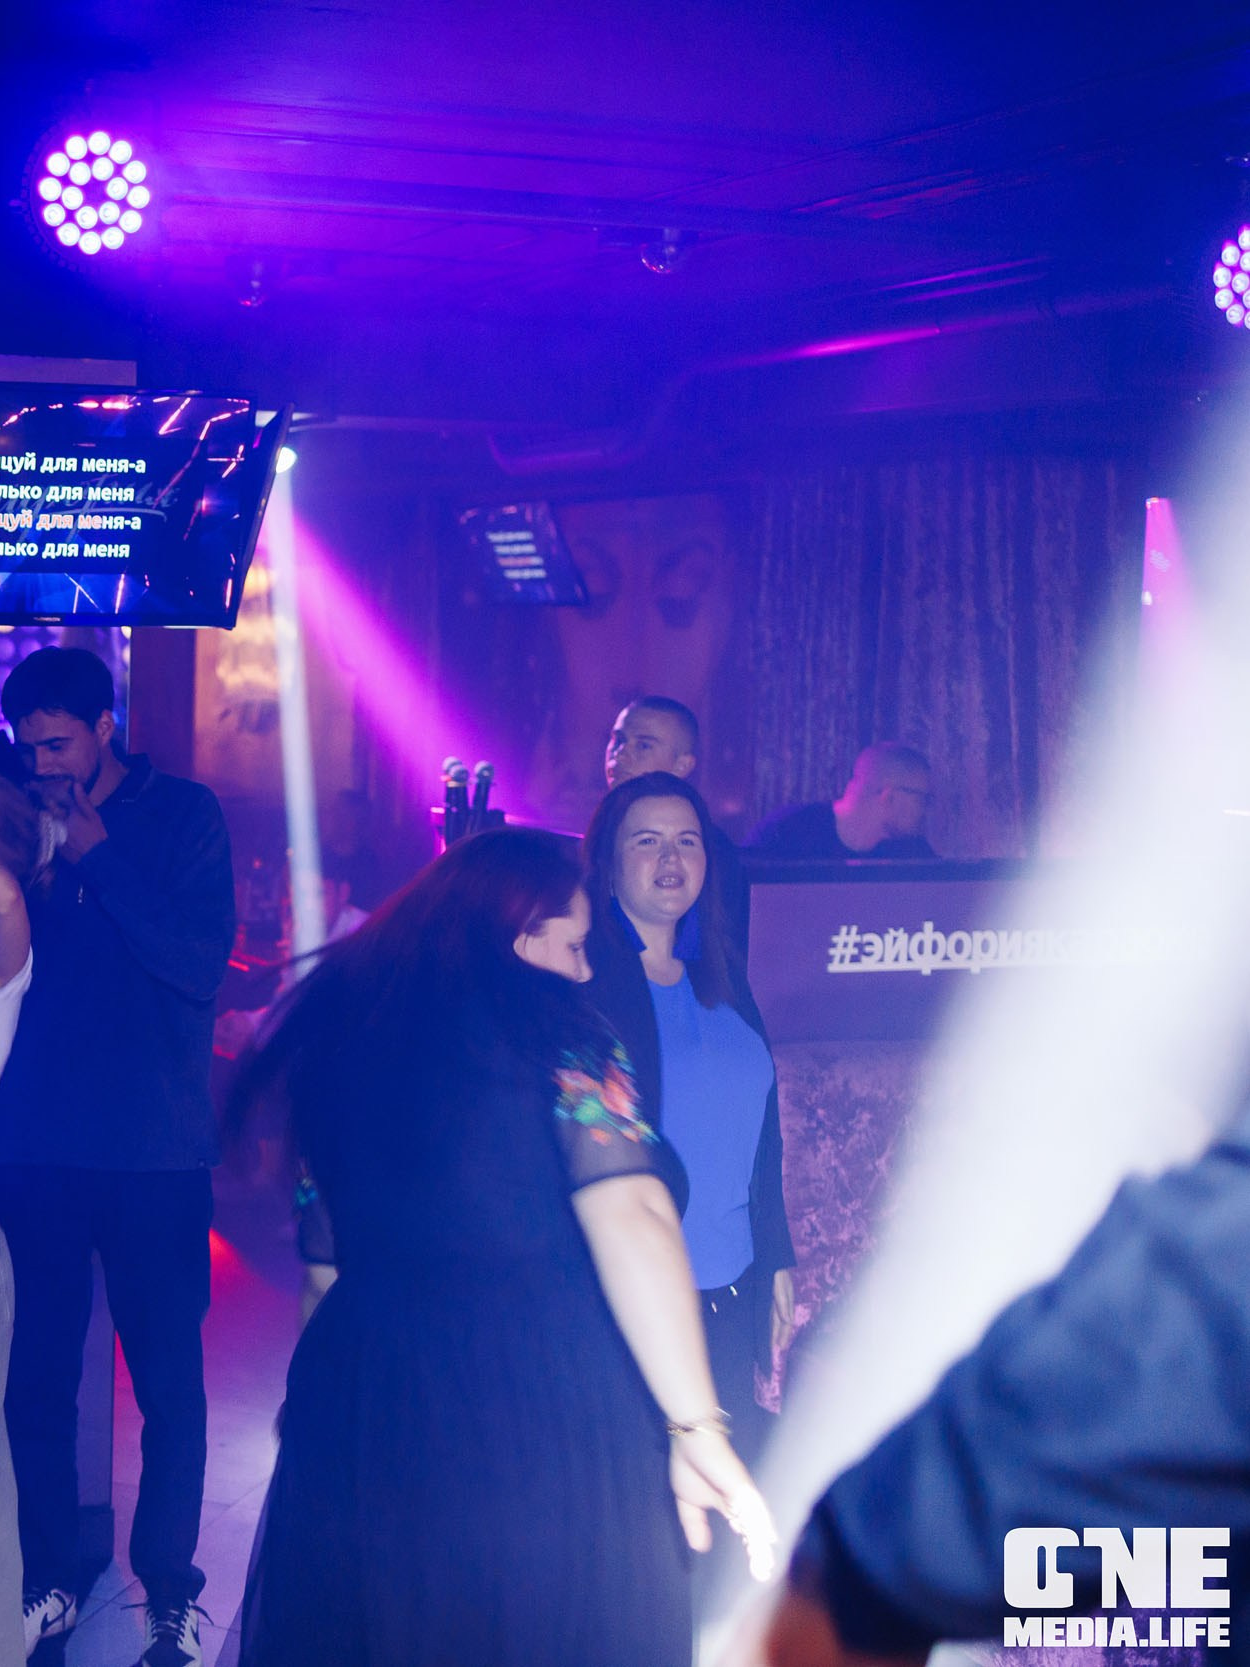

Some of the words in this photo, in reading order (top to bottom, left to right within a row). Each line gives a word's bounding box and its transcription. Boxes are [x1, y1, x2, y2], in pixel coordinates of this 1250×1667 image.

[40, 456, 77, 474] для
[82, 457, 146, 474] меня-а
[45, 485, 83, 502] для
[88, 486, 135, 502] меня
[36, 514, 73, 531] для
[77, 514, 141, 530] меня-а
[42, 542, 78, 559] для
[83, 543, 130, 558] меня
